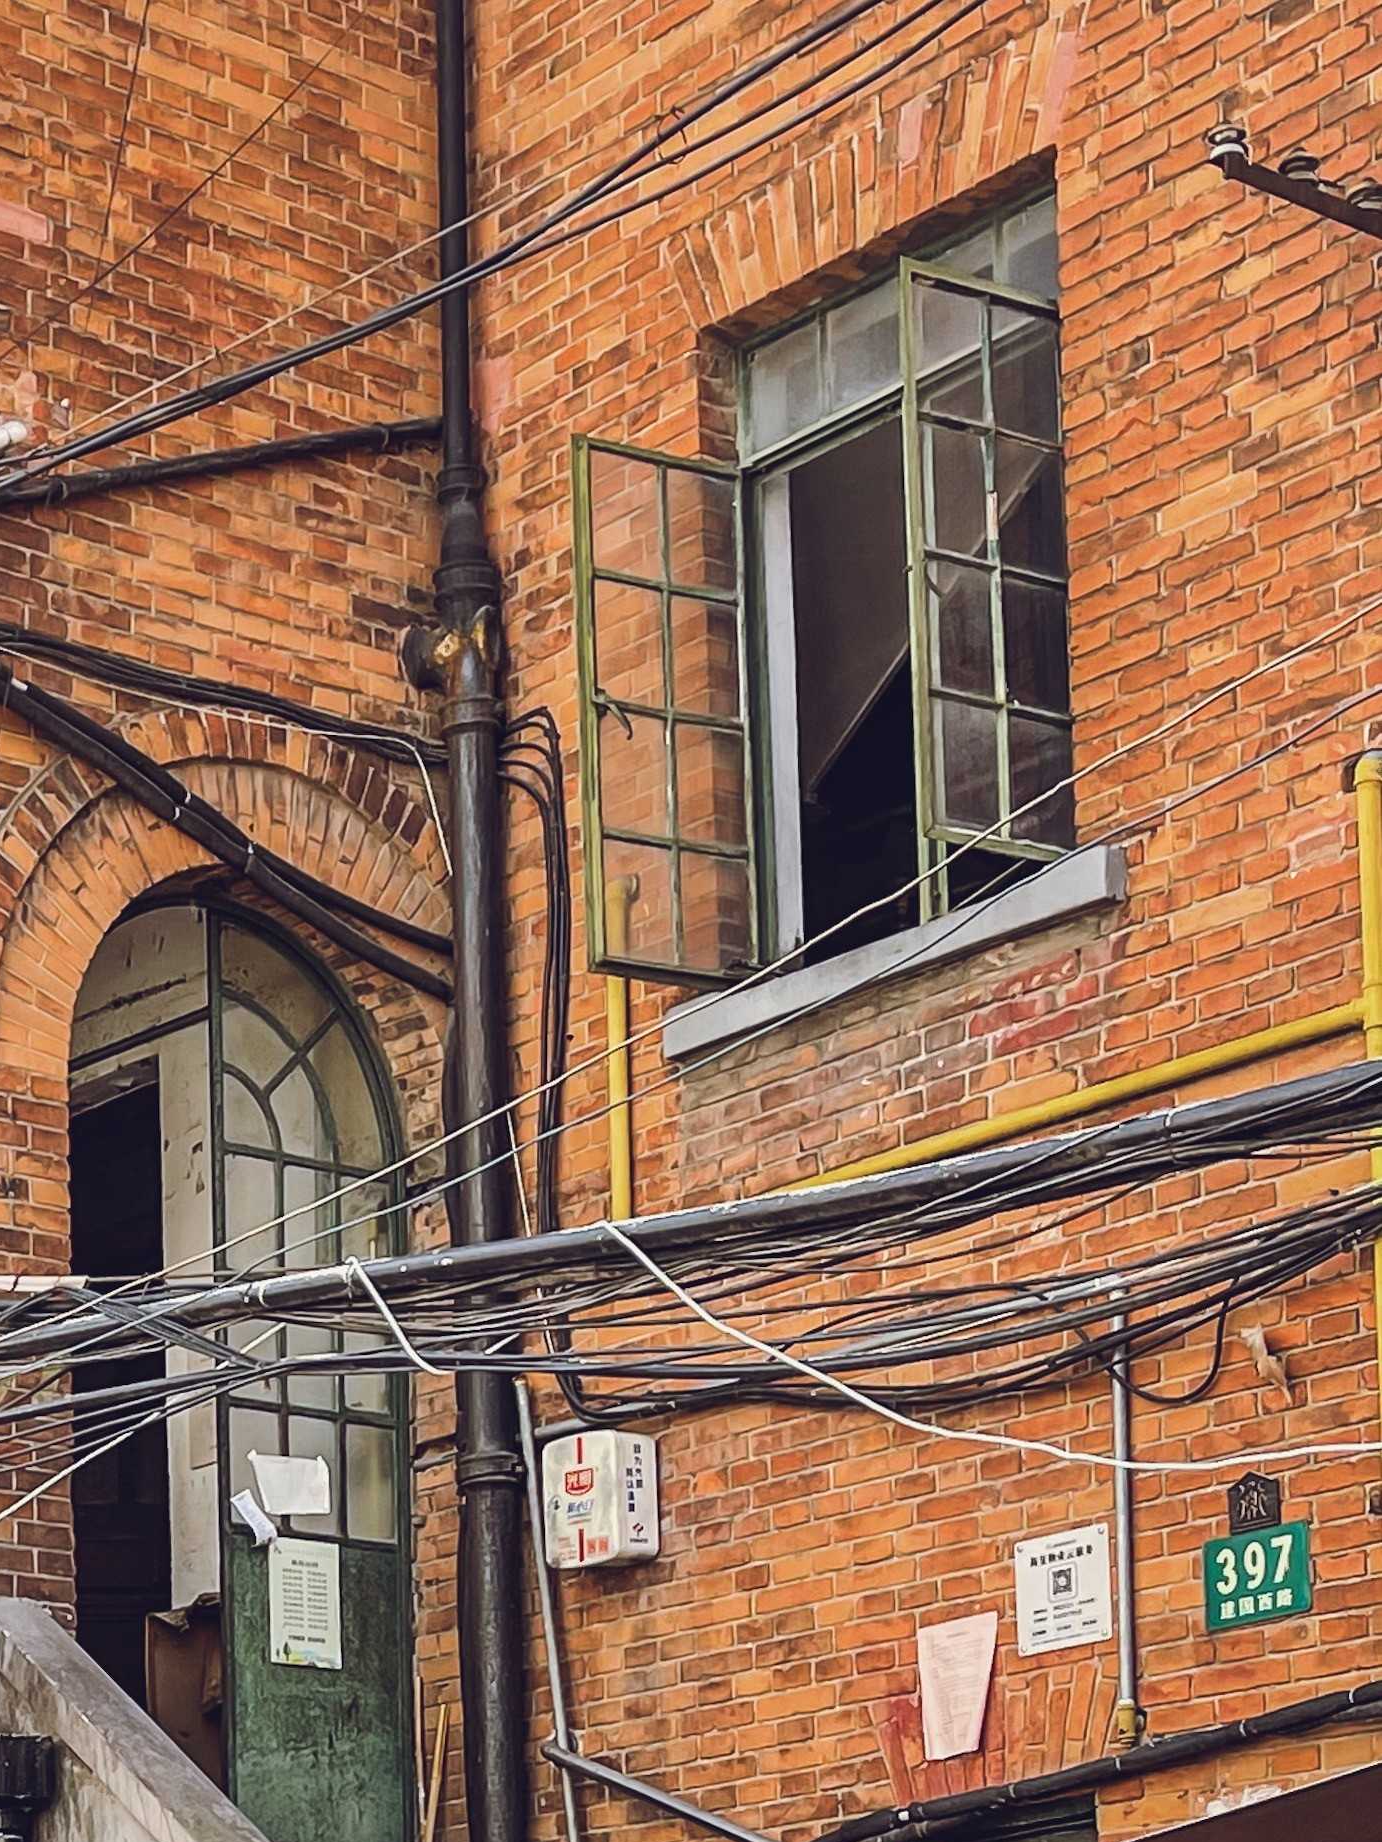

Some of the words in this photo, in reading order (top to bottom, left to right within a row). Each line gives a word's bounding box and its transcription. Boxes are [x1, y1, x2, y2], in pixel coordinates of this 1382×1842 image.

[1216, 1534, 1293, 1596] 397
[1220, 1588, 1293, 1620] 建国西路
